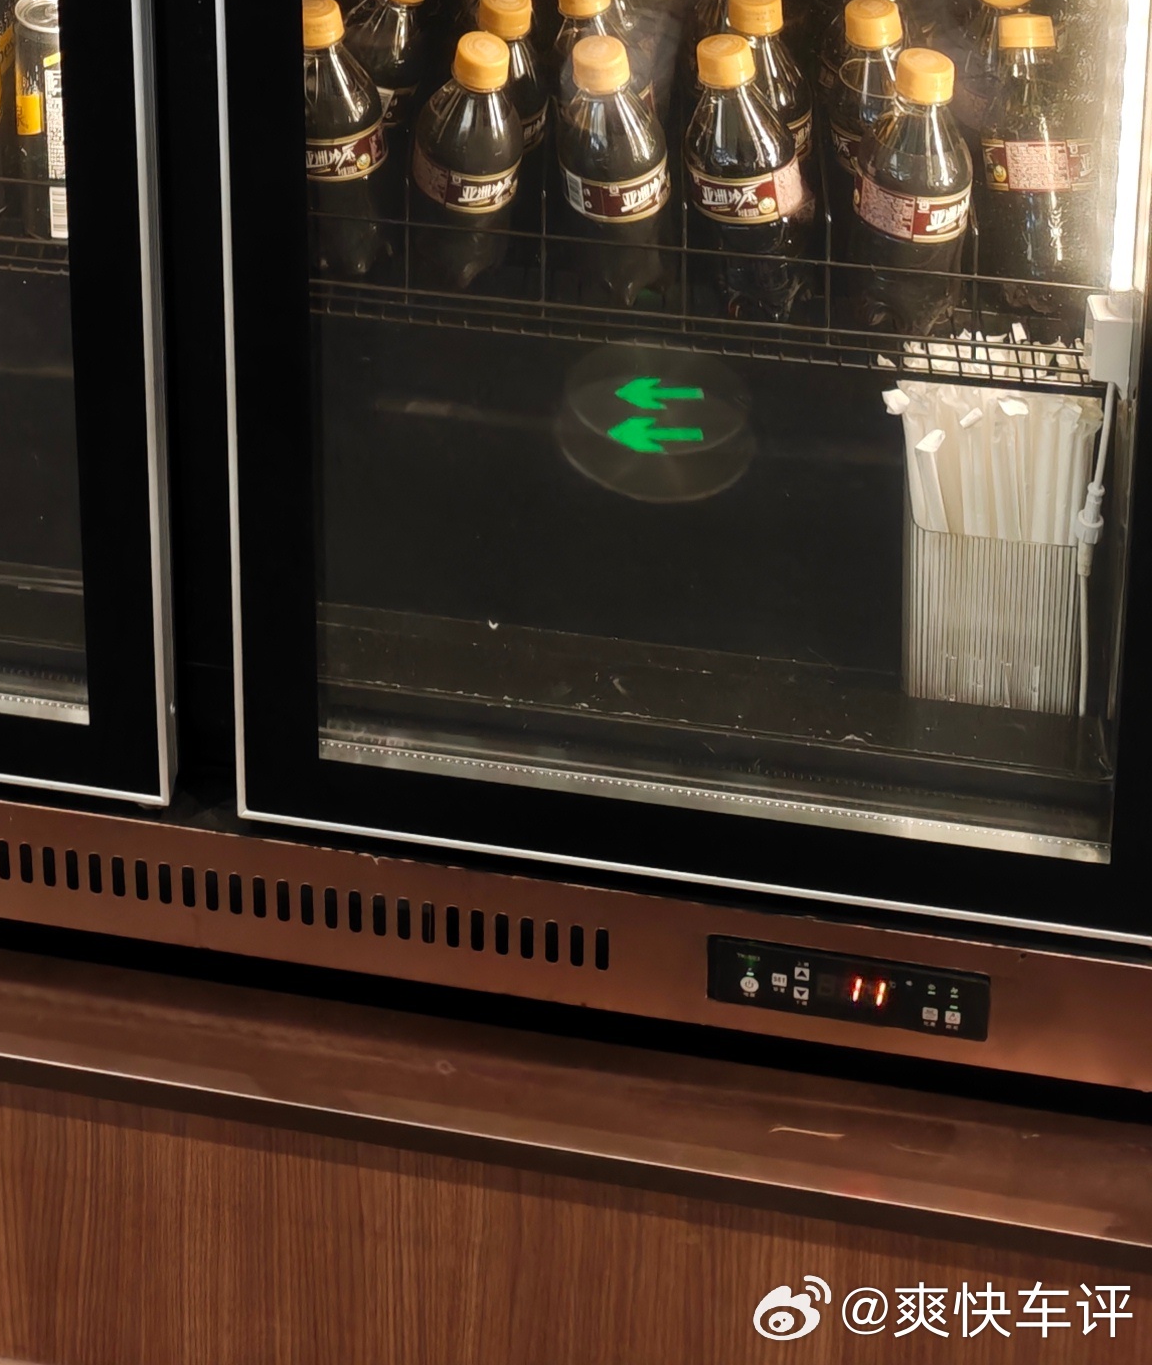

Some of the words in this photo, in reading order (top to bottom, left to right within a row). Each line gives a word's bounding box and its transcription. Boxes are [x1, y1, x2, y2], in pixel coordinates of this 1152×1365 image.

[926, 190, 970, 232] 亚洲沙
[772, 975, 787, 985] SET
[851, 976, 888, 1008] 11
